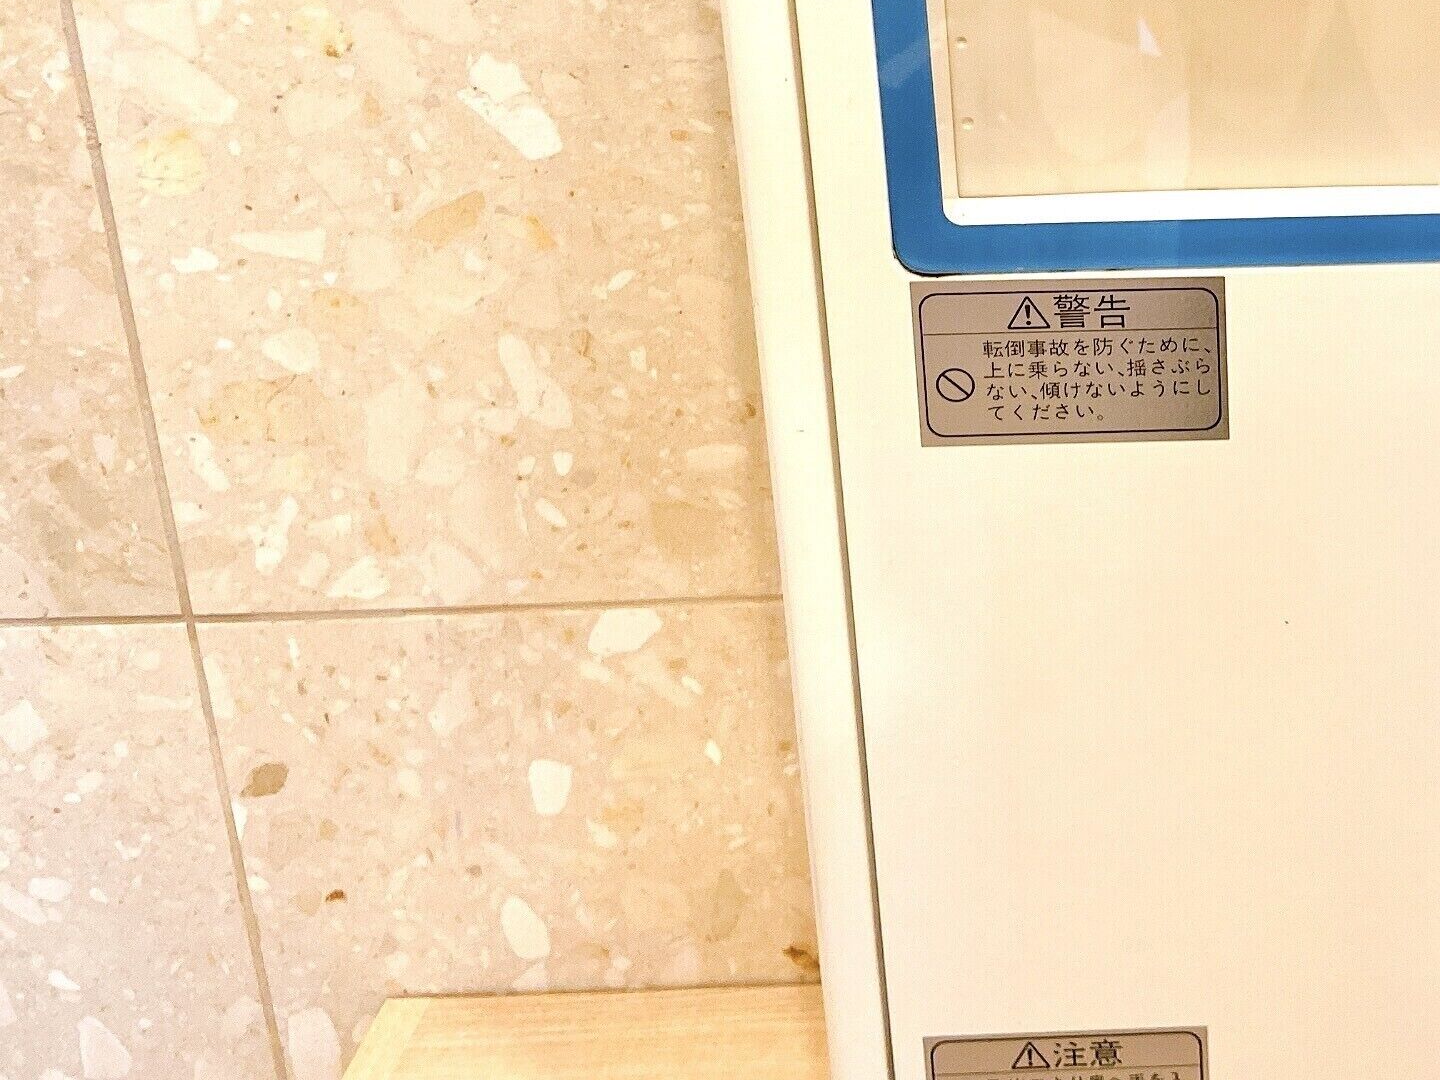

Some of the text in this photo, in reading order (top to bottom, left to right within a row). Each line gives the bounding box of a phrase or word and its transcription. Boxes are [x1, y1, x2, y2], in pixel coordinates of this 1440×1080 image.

[1053, 293, 1131, 330] 警告
[982, 336, 1212, 358] 転倒事故を防ぐために、
[983, 358, 1212, 380] 上に乗らない、揺さぶら
[986, 380, 1212, 401] ない、傾けないようにし
[987, 404, 1104, 422] てください。
[1054, 1038, 1124, 1068] 注意
